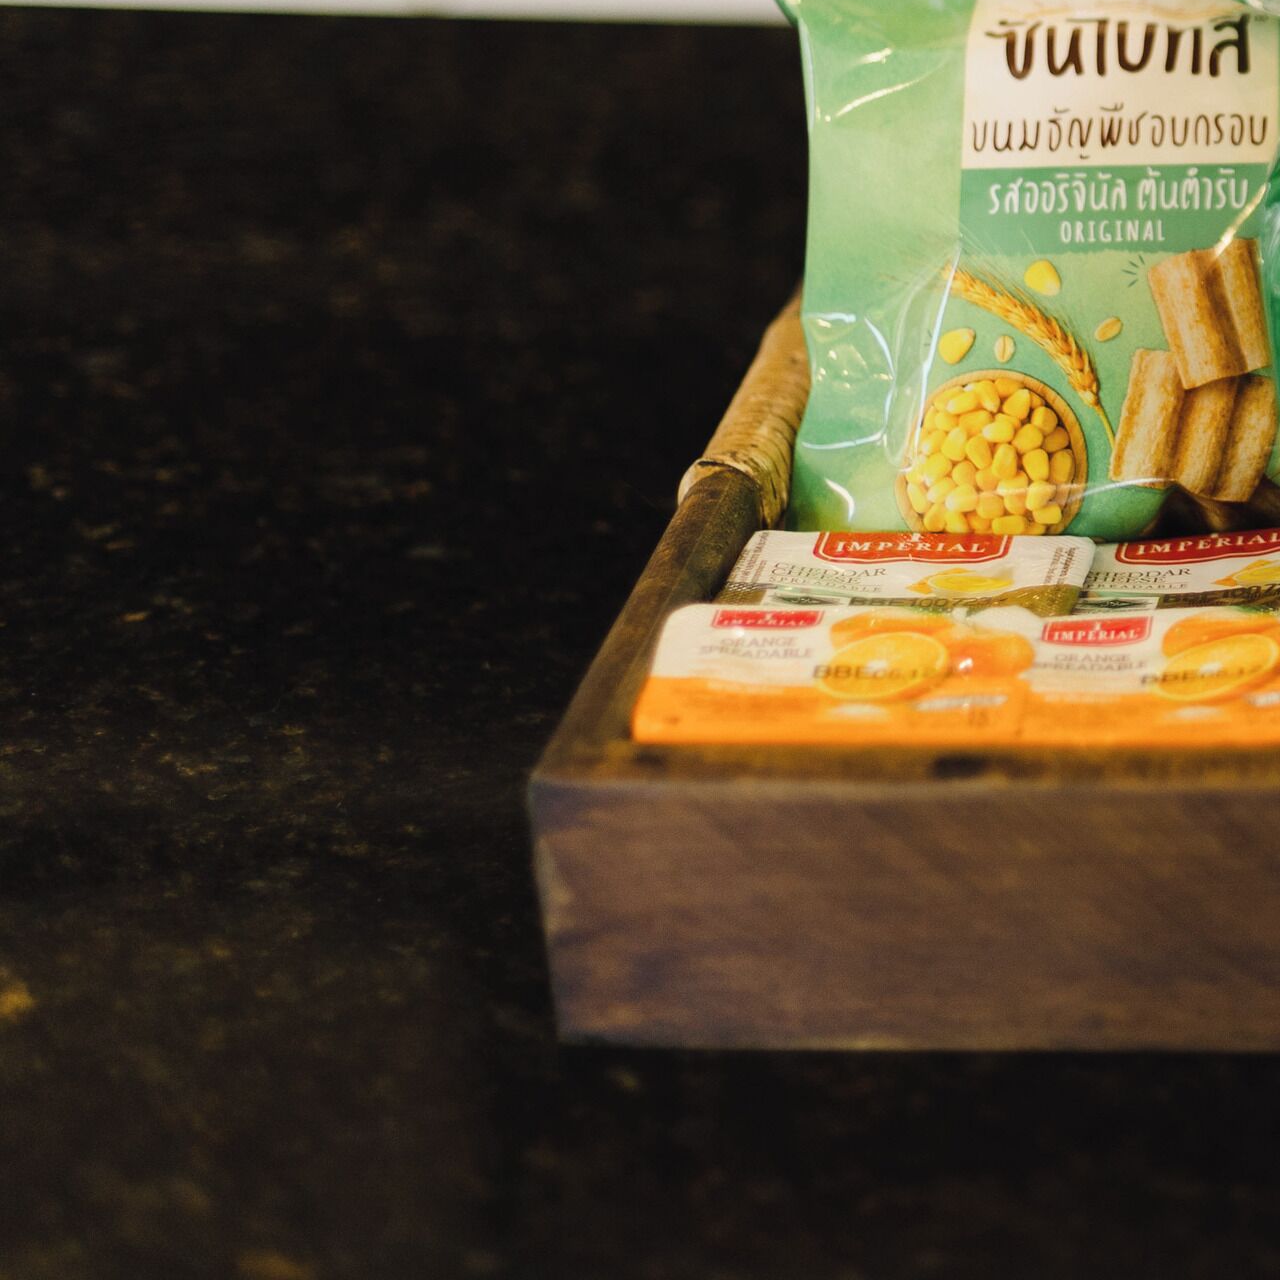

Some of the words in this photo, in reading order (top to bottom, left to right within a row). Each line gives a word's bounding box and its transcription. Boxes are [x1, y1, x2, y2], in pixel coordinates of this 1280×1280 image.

[972, 102, 1268, 160] ขนมธัญพืชอบกรอบ
[988, 170, 1127, 215] รสออริจินัล
[1137, 166, 1249, 211] ต้นตำรับ
[1059, 219, 1166, 244] ORIGINAL
[835, 540, 987, 554] IMPERIAL
[719, 636, 798, 648] ORANGE
[1052, 628, 1140, 642] IMPERIAL
[700, 646, 814, 660] SPREADABLE
[1054, 653, 1131, 663] ORANGE
